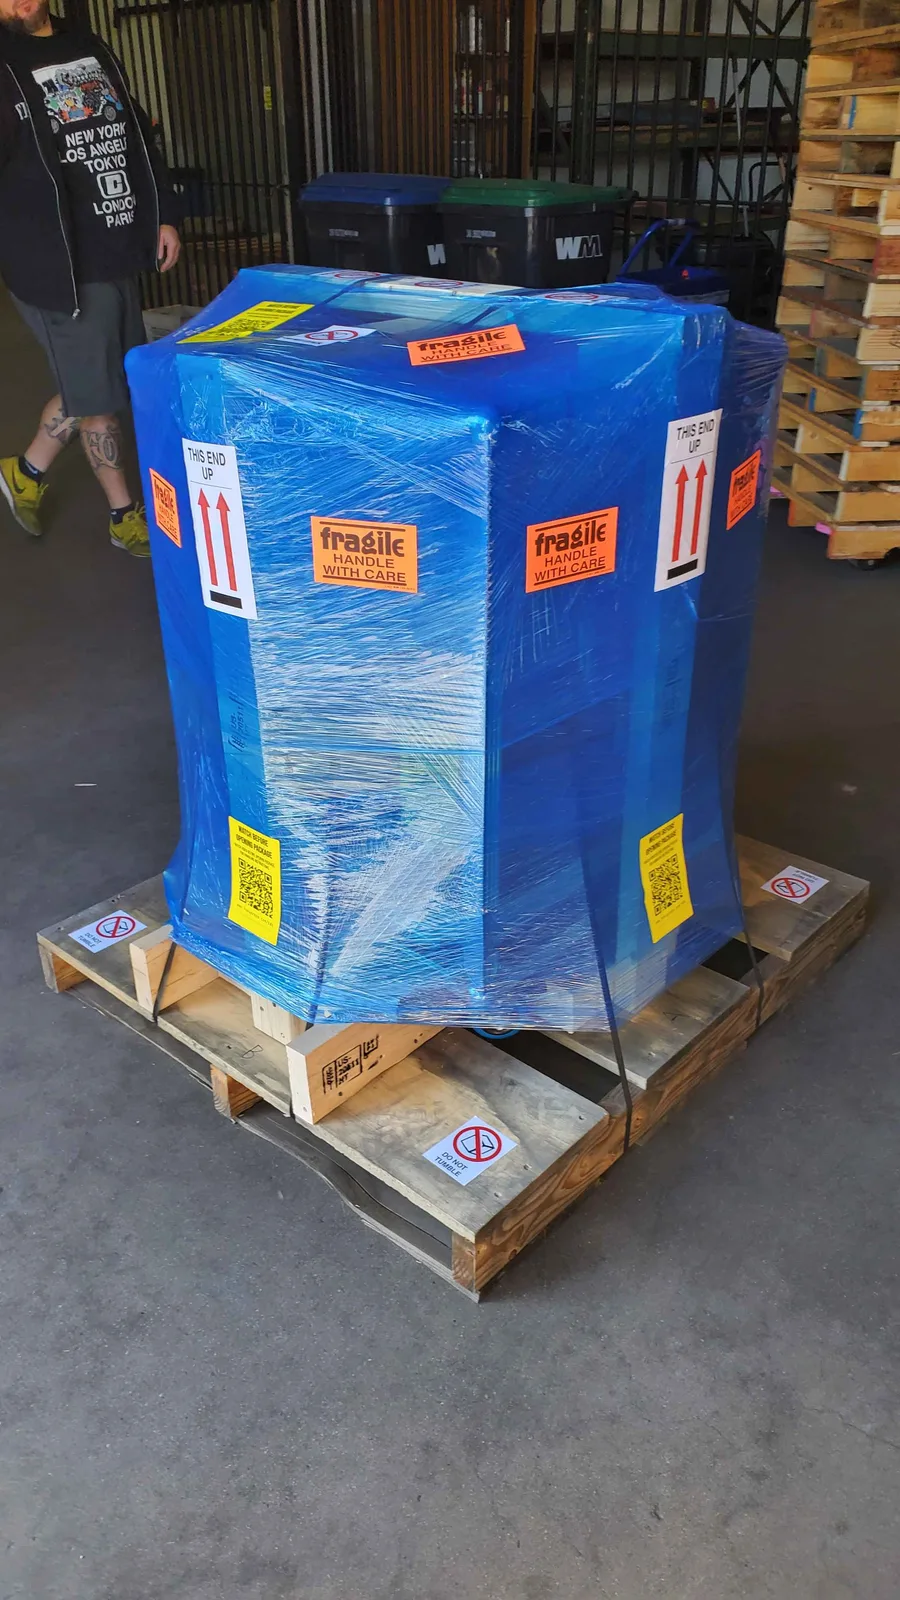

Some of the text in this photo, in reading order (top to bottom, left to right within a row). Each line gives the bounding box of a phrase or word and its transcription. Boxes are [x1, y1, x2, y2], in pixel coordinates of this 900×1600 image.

[65, 122, 126, 148] NEW YORK
[84, 154, 126, 173] TOKYO
[556, 234, 603, 260] WM
[418, 332, 506, 352] fragile
[432, 341, 497, 354] HANDLE
[421, 344, 512, 361] WITH CARE
[677, 419, 714, 440] THIS END
[688, 439, 701, 454] UP
[188, 447, 226, 466] THIS END
[202, 466, 214, 480] UP
[320, 526, 404, 558] fragile
[535, 520, 606, 556] fragile
[333, 554, 395, 568] HANDLE
[544, 546, 597, 567] HANDLE
[322, 564, 406, 582] WITH CARE
[534, 566, 566, 582] WITH
[570, 556, 606, 572] CARE
[434, 1156, 462, 1178] TUMBLE
[442, 1152, 468, 1170] DO NOT
